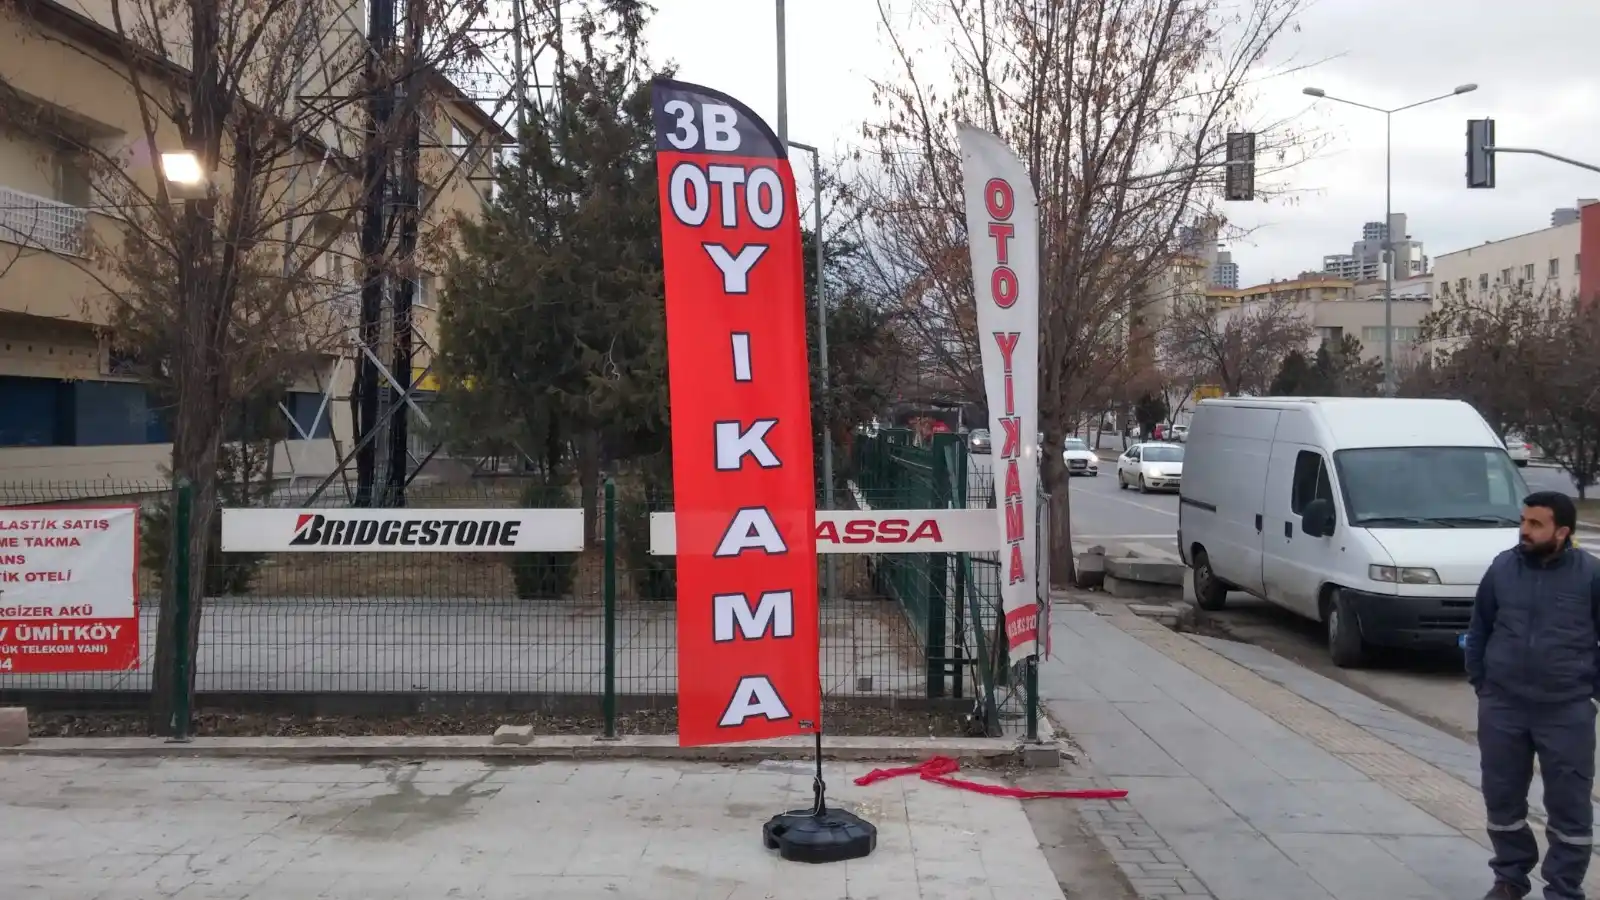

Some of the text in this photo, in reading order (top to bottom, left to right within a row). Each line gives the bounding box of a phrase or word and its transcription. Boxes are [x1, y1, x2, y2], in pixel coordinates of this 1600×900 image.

[663, 100, 741, 151] 3B
[669, 161, 785, 230] OTO
[702, 241, 795, 728] YIKAMA
[62, 519, 110, 531] SATIŞ
[289, 514, 521, 546] BRIDGESTONE
[815, 519, 943, 544] ASSA
[24, 537, 81, 548] TAKMA
[0, 569, 72, 582] İK OTELİ
[59, 604, 93, 616] AKÜ
[15, 623, 121, 641] ÜMİTKÖY
[0, 645, 18, 654] ÜK
[21, 645, 74, 654] TELEKOM
